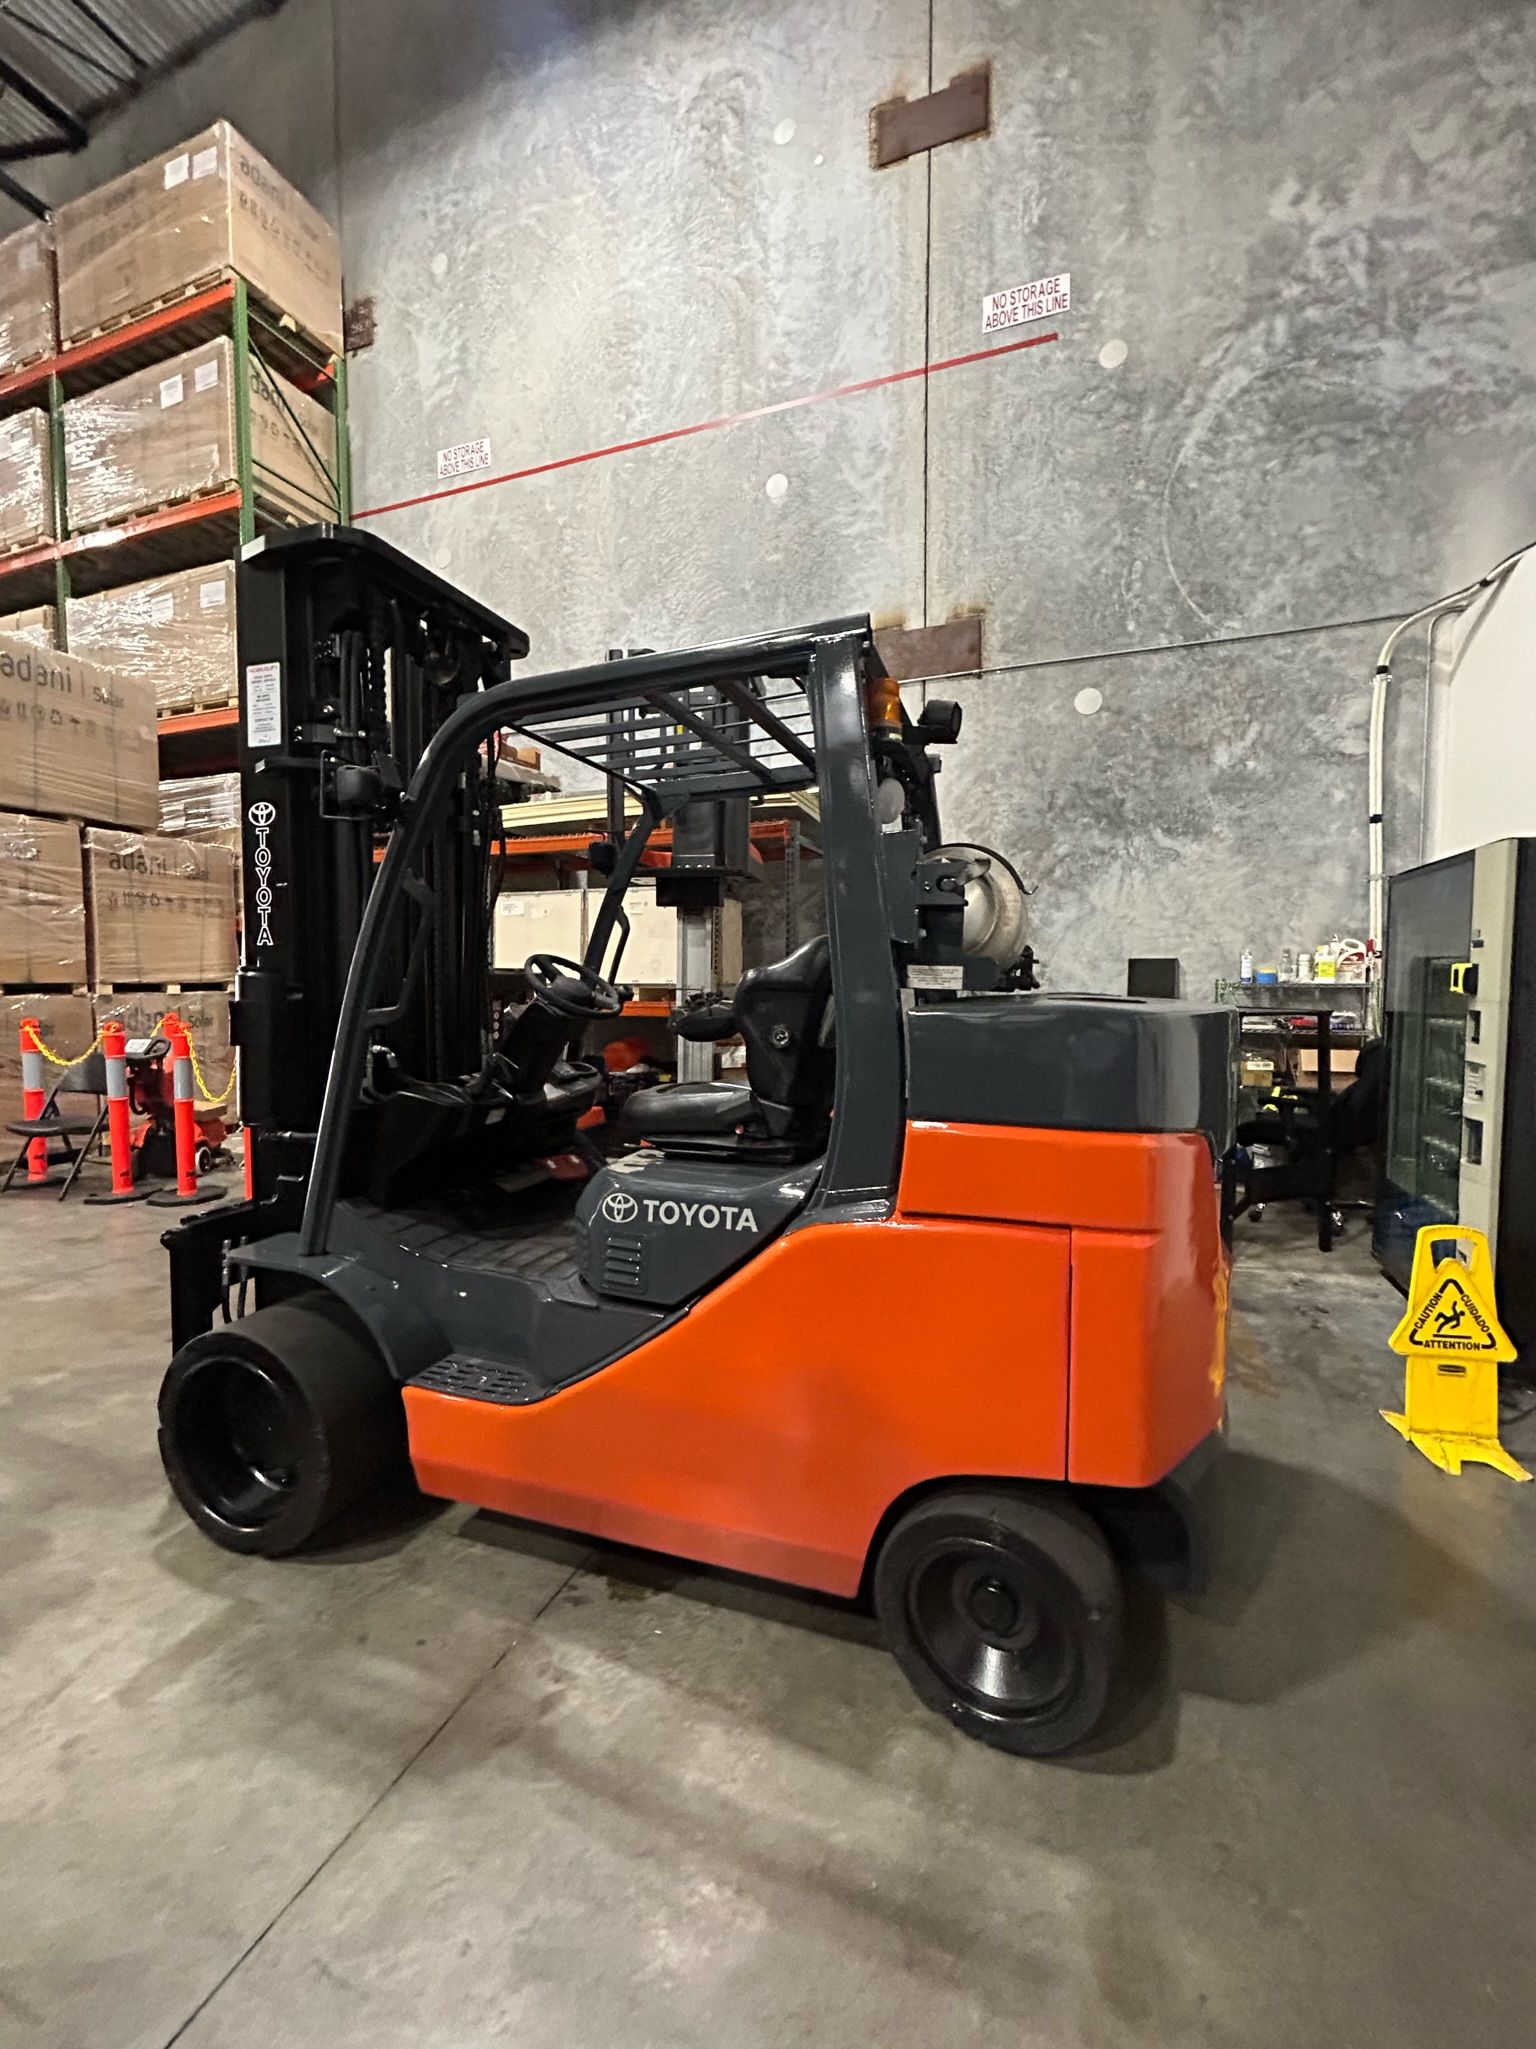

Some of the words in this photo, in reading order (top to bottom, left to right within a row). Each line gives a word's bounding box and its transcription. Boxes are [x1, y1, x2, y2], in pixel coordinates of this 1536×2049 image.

[985, 306, 1019, 330] ABOVE
[1022, 300, 1043, 320] THIS
[1046, 293, 1069, 313] LINE
[992, 293, 1007, 311] NO
[1010, 278, 1061, 306] STORAGE
[440, 462, 460, 475] ABOVE
[461, 457, 474, 471] THIS
[475, 453, 489, 468] LINE
[443, 450, 452, 462] NO
[453, 441, 484, 460] STORAGE
[0, 652, 72, 693] adani
[255, 827, 273, 946] TOYOTA
[643, 1199, 759, 1233] TOYOTA
[1414, 1292, 1443, 1331] CAUTION
[1460, 1293, 1490, 1334] CUIDADO
[1424, 1339, 1481, 1351] ATTENTION
